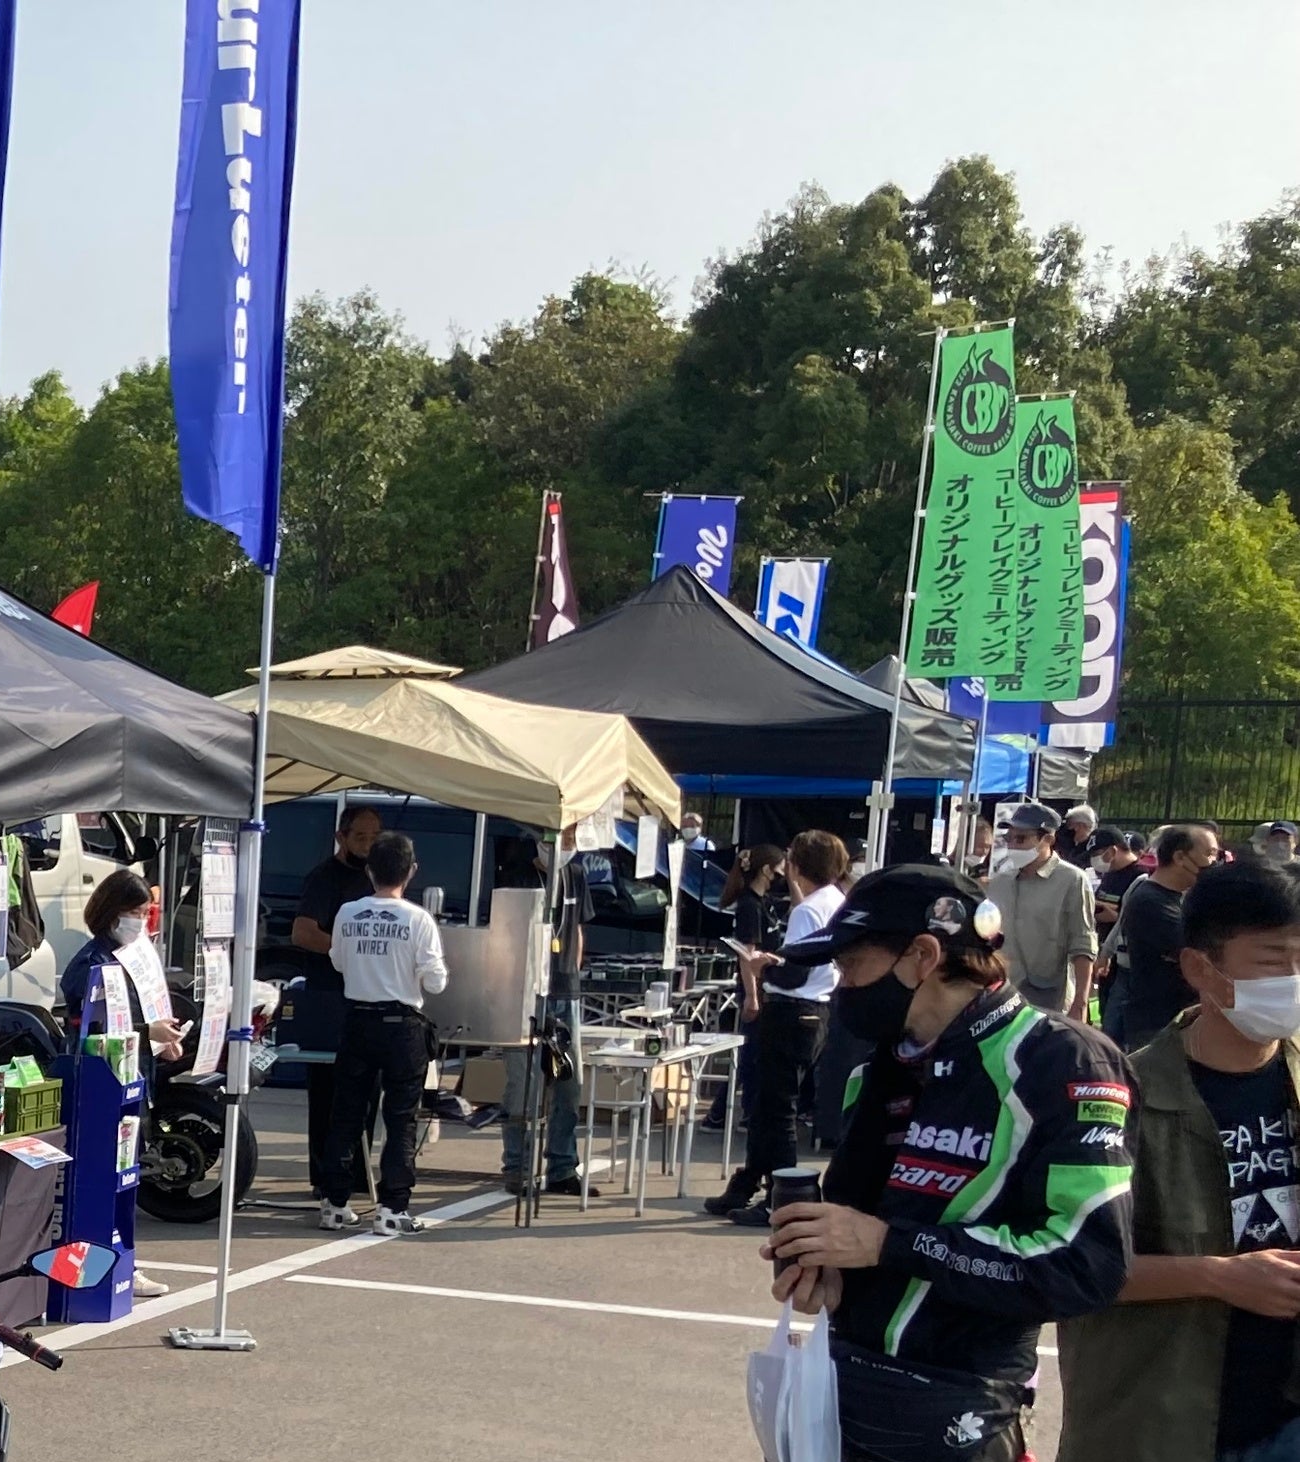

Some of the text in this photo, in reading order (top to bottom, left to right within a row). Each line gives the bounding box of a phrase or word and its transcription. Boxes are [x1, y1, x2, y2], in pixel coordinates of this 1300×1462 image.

[962, 438, 991, 455] COFFEE
[920, 473, 974, 668] オリジナルグッズ販売
[372, 922, 410, 941] SHARKS
[356, 939, 389, 956] AVIREX
